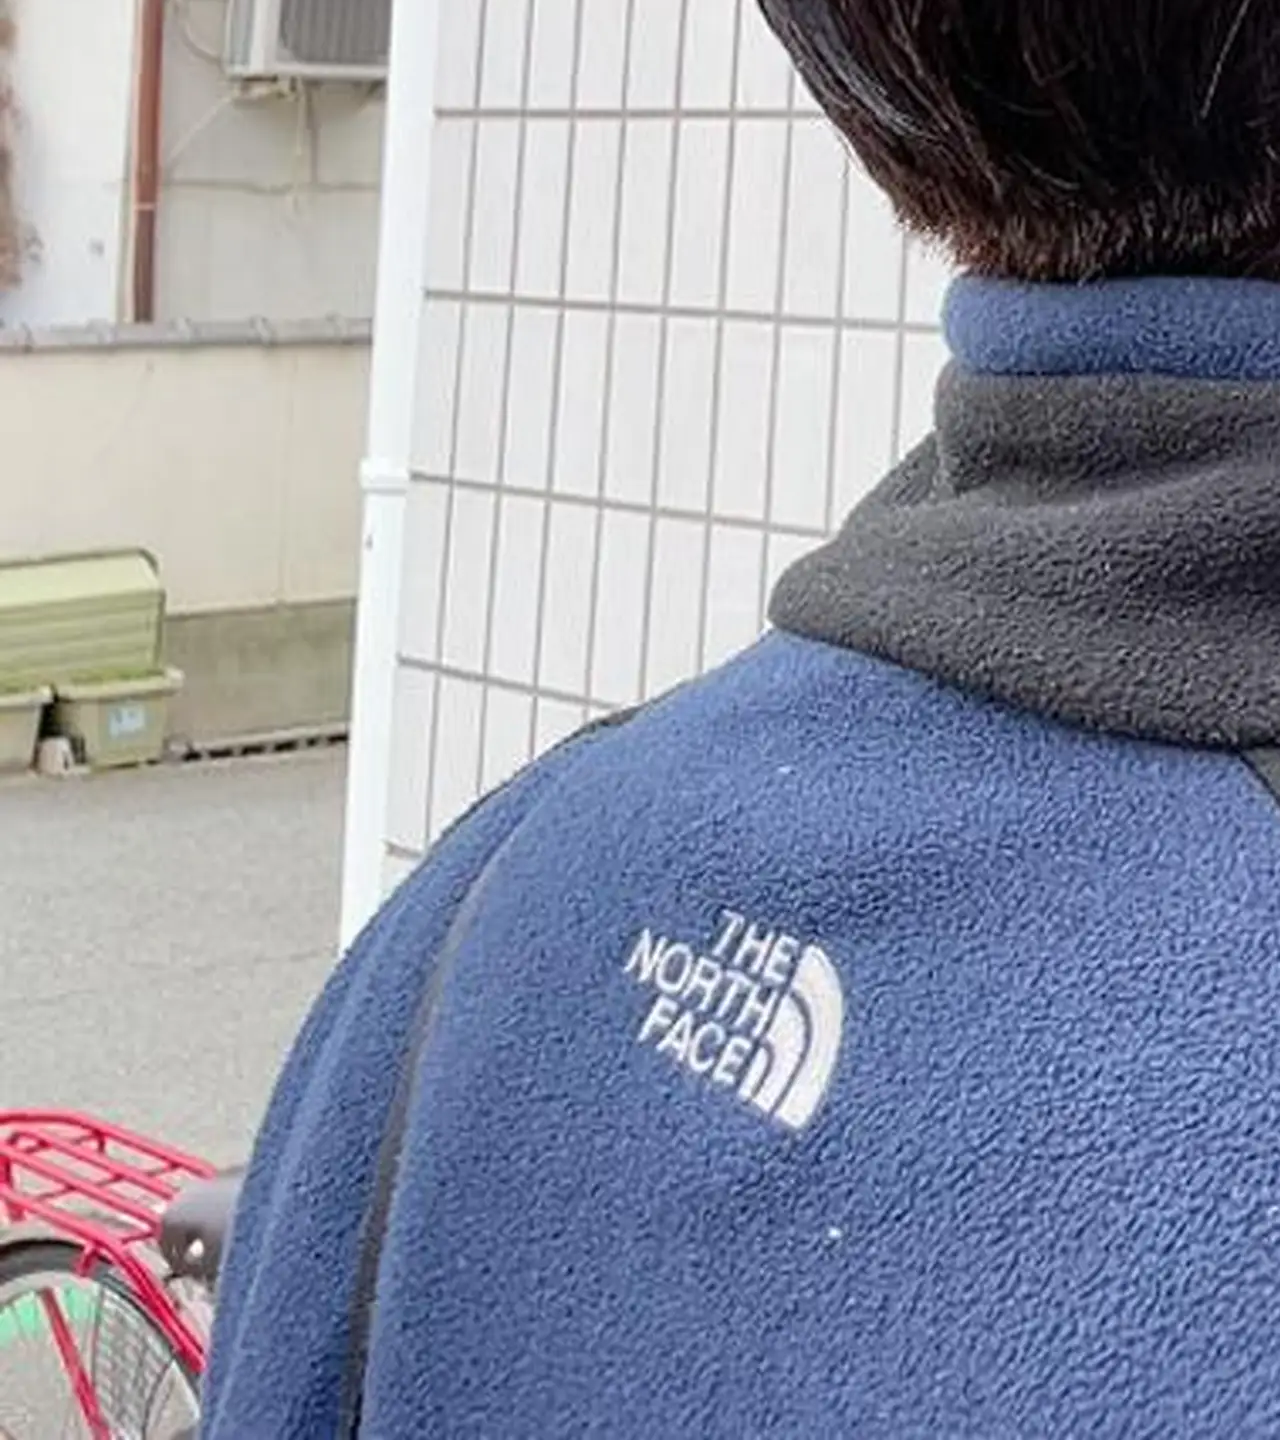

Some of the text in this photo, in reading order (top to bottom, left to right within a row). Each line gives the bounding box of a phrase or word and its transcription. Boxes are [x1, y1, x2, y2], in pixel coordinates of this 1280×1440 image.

[622, 927, 778, 1038] NORTH
[711, 910, 801, 985] THE
[637, 996, 752, 1085] FACE
